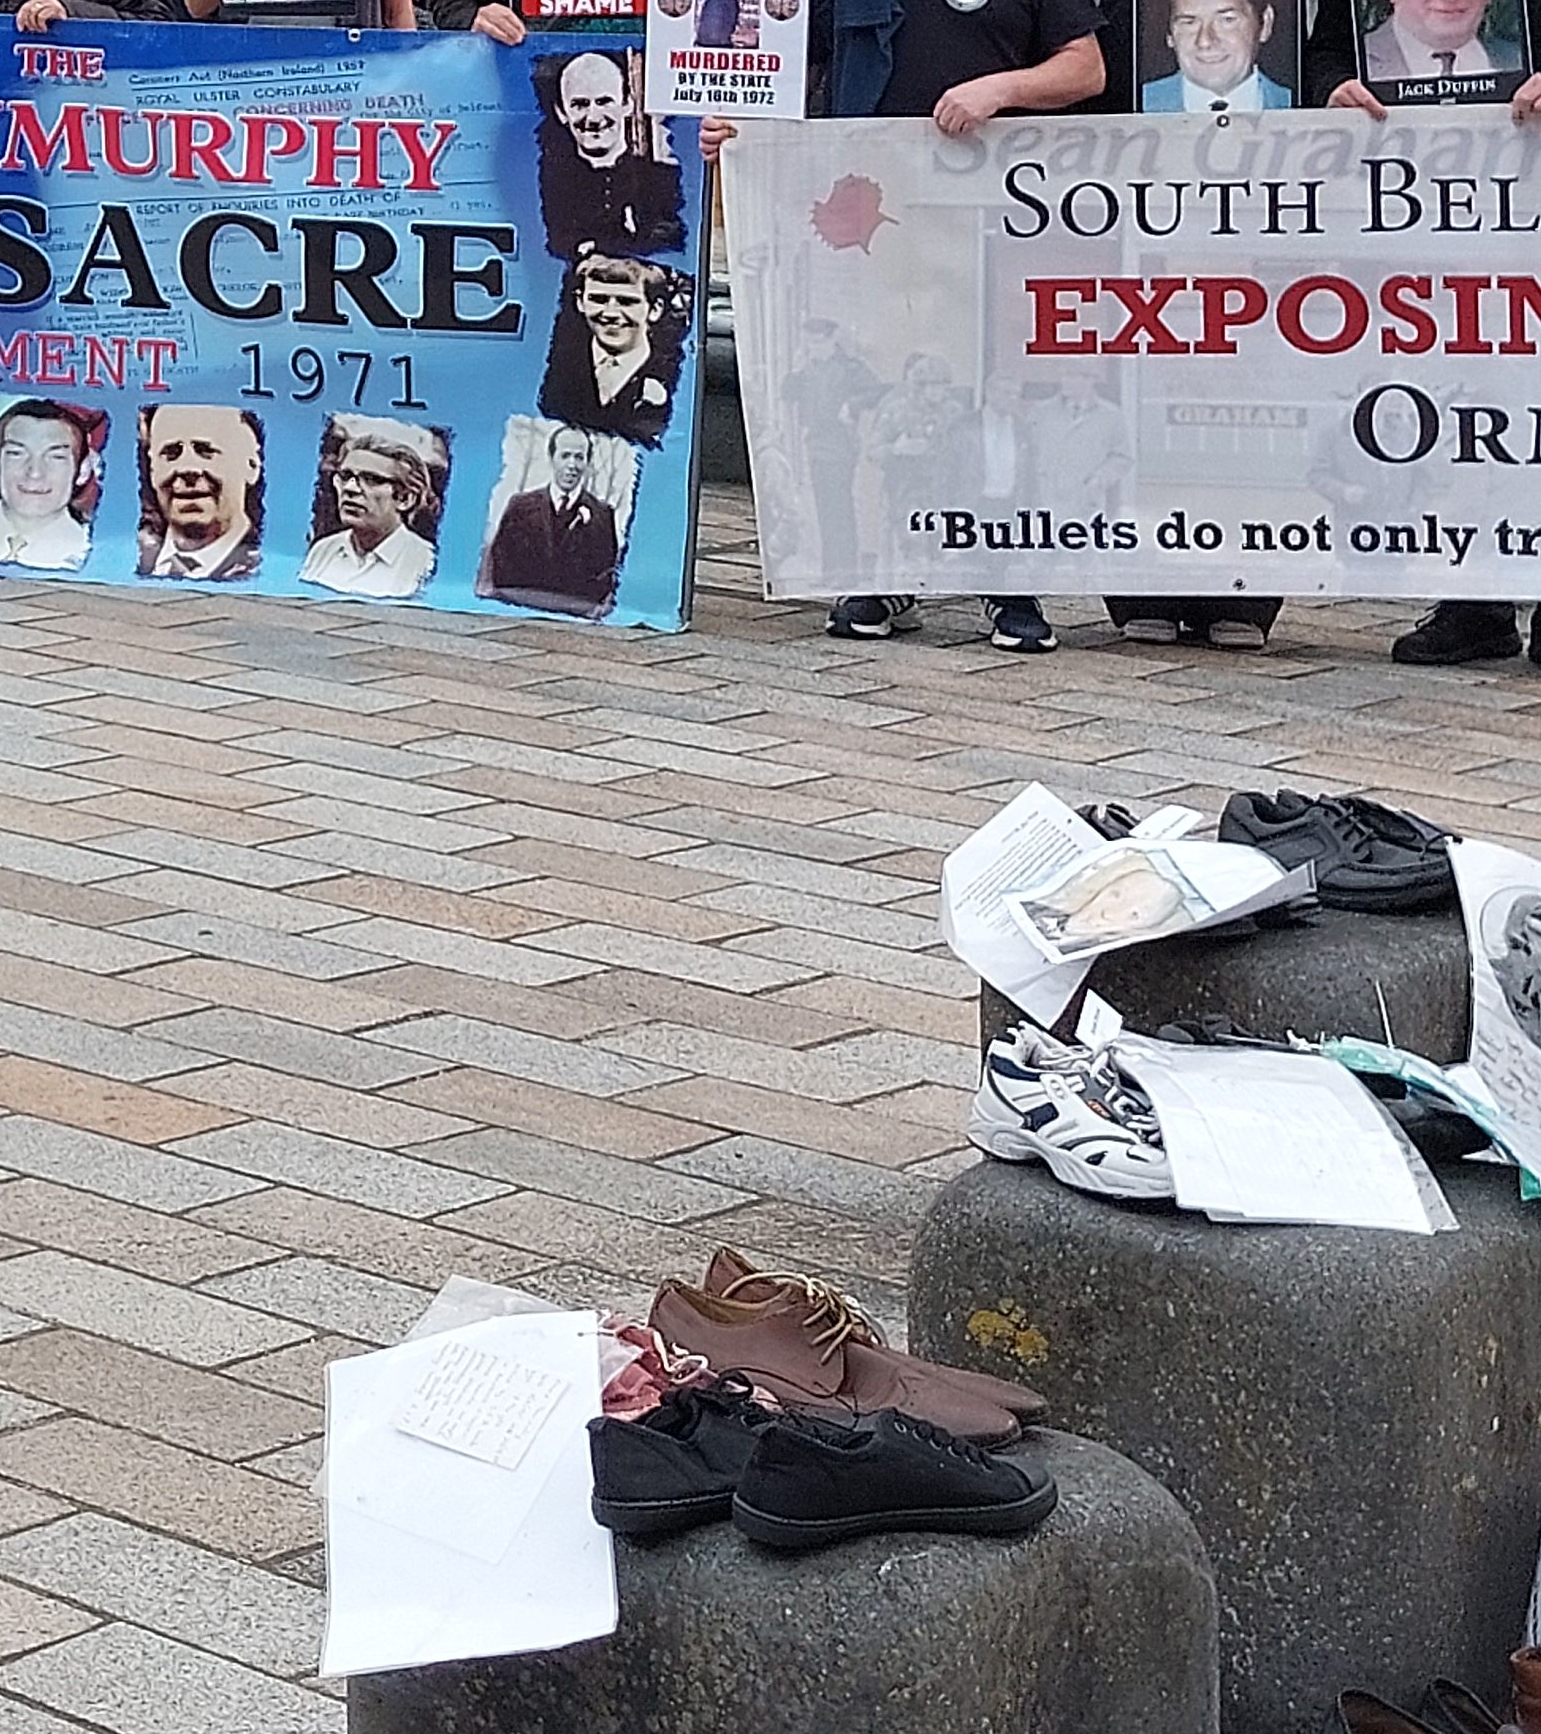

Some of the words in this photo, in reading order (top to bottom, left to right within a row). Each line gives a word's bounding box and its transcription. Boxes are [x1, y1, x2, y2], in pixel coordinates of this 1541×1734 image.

[14, 43, 105, 82] THE
[670, 50, 781, 73] MURDERED
[678, 72, 697, 86] BY
[701, 73, 726, 87] THE
[730, 74, 772, 88] STATE
[1397, 81, 1435, 100] JACK
[238, 342, 428, 411] 1971
[1351, 381, 1541, 466] OR
[1155, 510, 1223, 553] do
[1240, 515, 1333, 554] not
[1348, 513, 1479, 566] only
